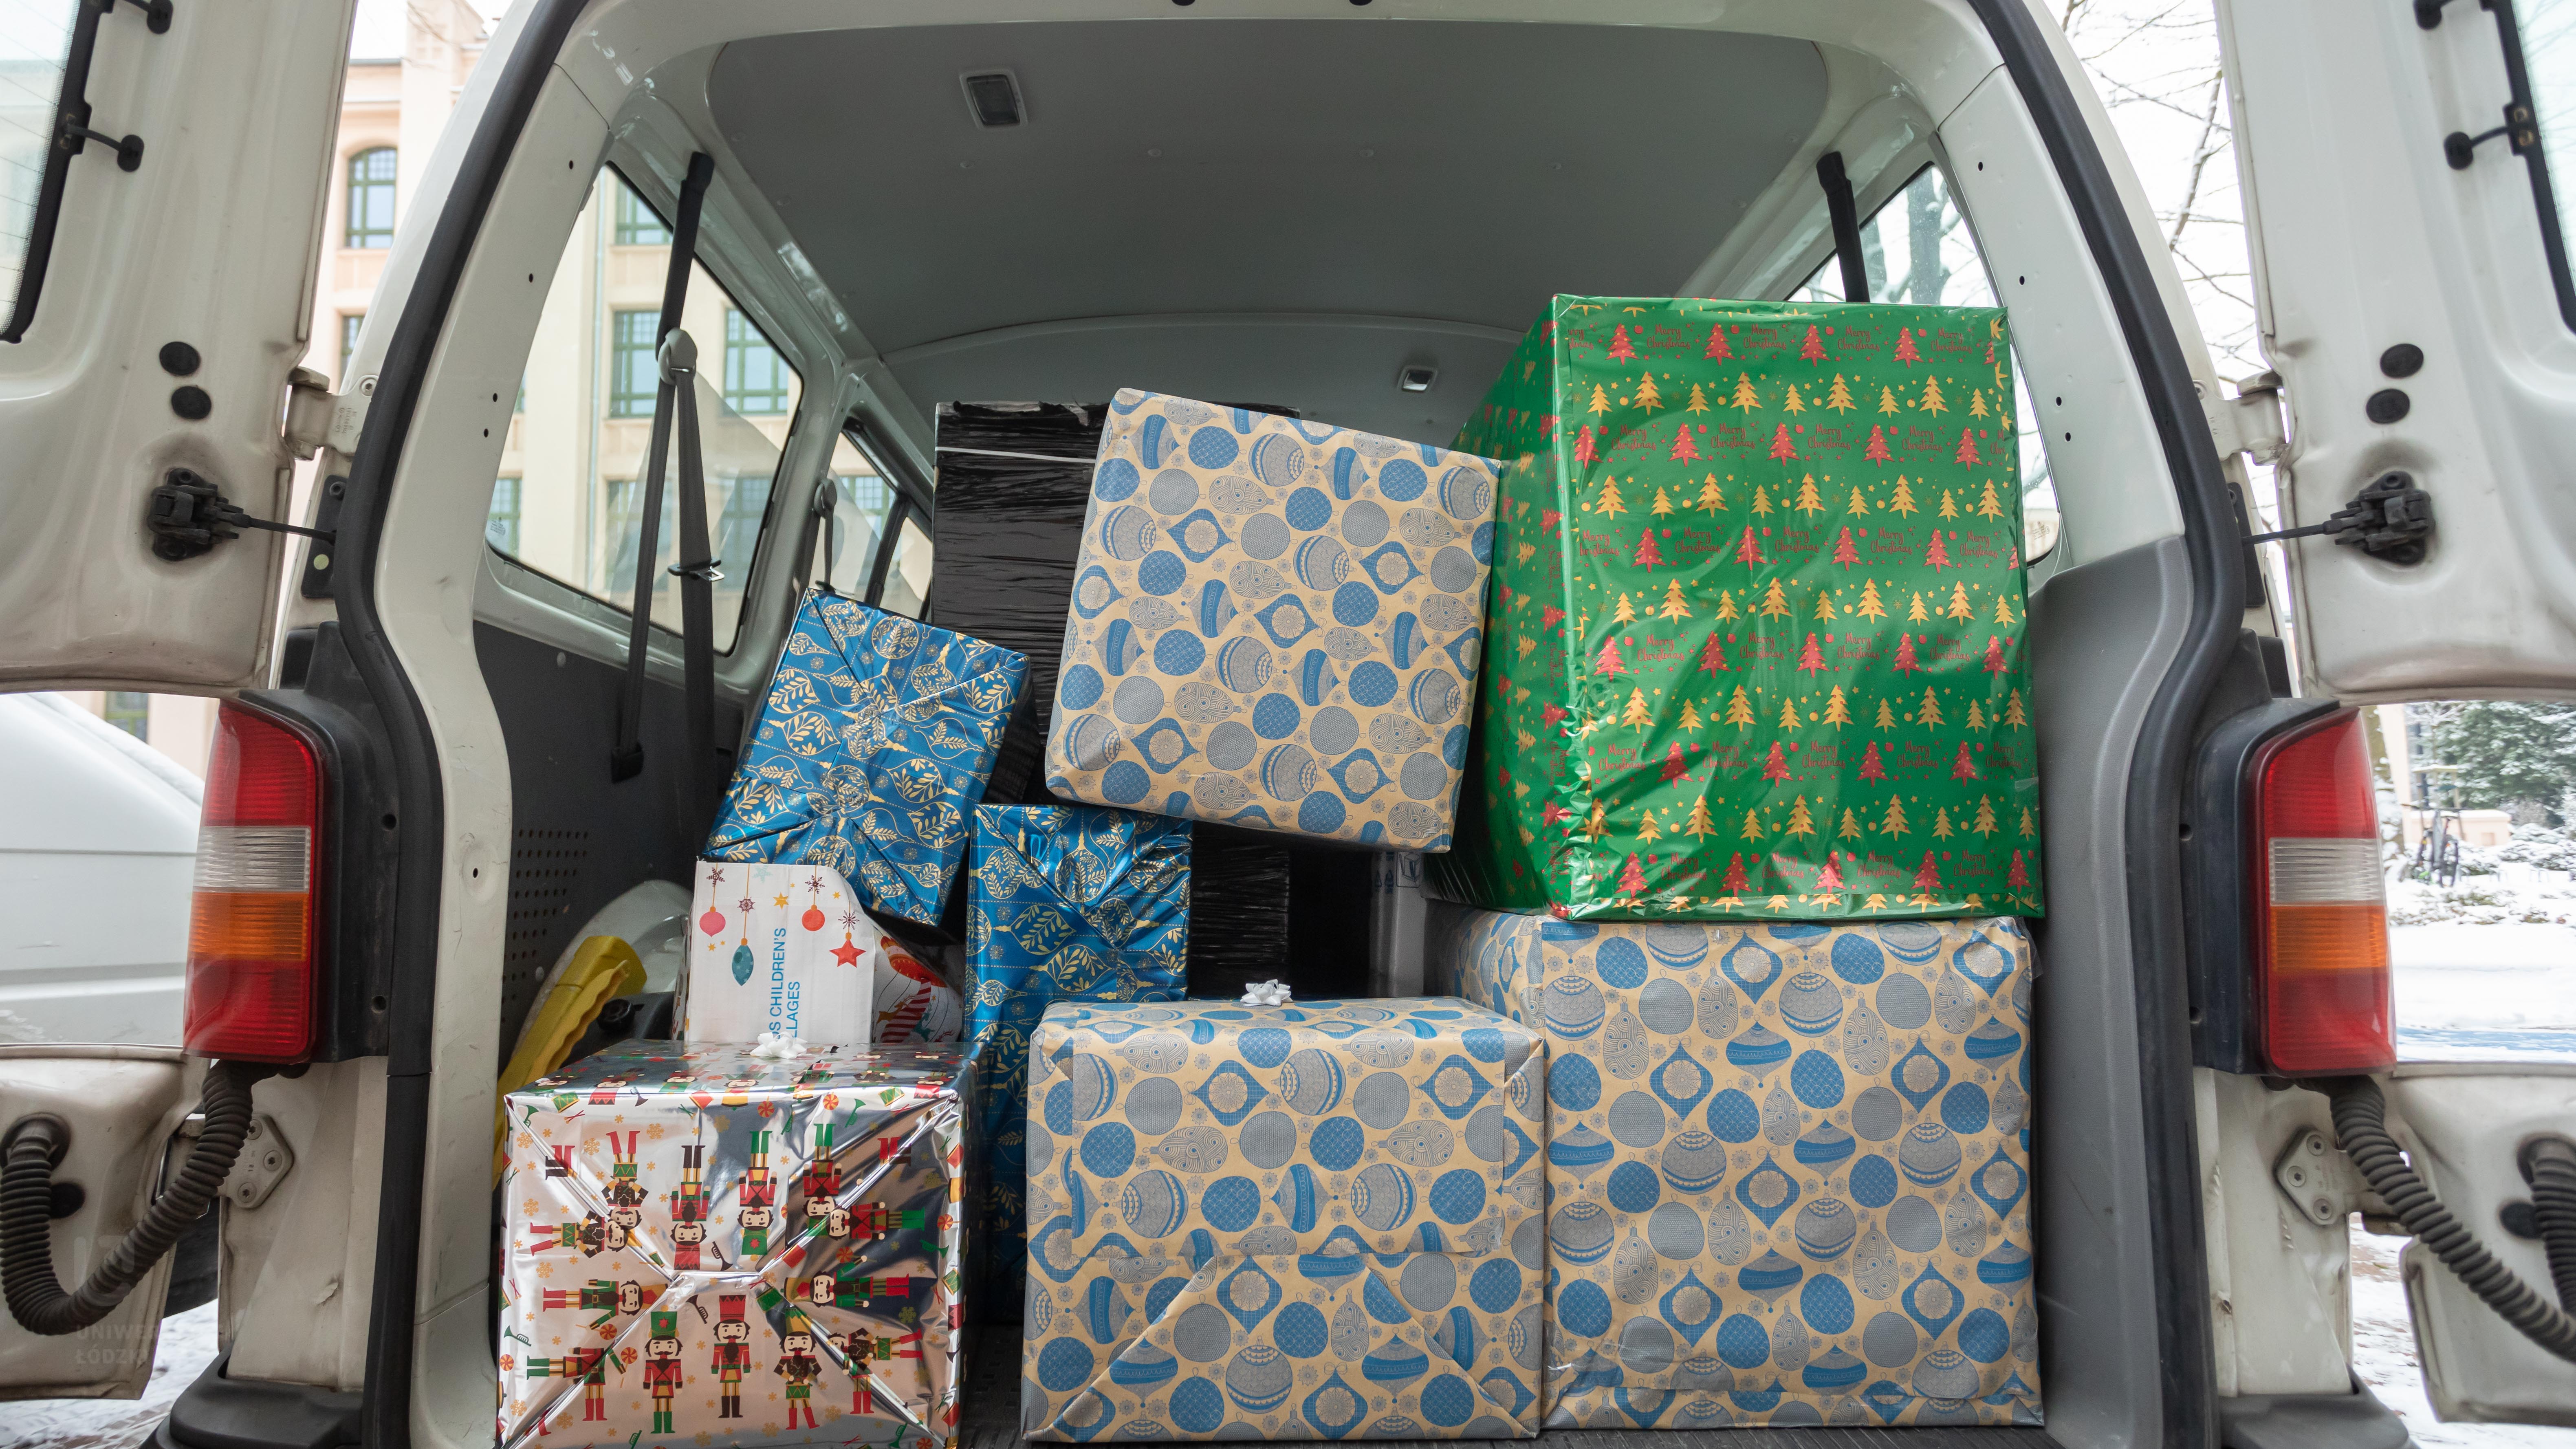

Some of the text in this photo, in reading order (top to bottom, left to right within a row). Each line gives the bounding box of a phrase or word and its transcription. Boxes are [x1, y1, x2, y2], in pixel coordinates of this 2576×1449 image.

[1655, 324, 1681, 342] Merry
[1752, 324, 1777, 342] Merry
[1845, 326, 1870, 344] Merry
[1938, 328, 1963, 344] Merry
[1647, 336, 1691, 350] Christmas
[1744, 337, 1786, 350] Christmas
[1838, 338, 1880, 352] Christmas
[1931, 340, 1972, 354] Christmas
[1620, 424, 1647, 443] Merry
[1719, 423, 1746, 442] Merry
[1816, 423, 1841, 442] Merry
[1910, 425, 1934, 445] Merry
[1612, 436, 1656, 451] Christmas
[1711, 435, 1755, 449] Christmas
[1808, 436, 1851, 450] Christmas
[1902, 437, 1943, 452] Christmas
[1583, 530, 1610, 548] Merry
[1684, 527, 1711, 544] Merry
[1783, 526, 1809, 544] Merry
[1878, 527, 1904, 544] Merry
[1967, 531, 1990, 547] Merry
[1675, 540, 1721, 554] Christmas
[1775, 538, 1819, 553] Christmas
[1871, 540, 1913, 555] Christmas
[1960, 544, 1998, 559] Christmas
[1647, 634, 1674, 652] Merry
[1749, 632, 1775, 650] Merry
[1845, 632, 1871, 651] Merry
[1937, 634, 1961, 652] Merry
[1638, 647, 1684, 662] Christmas
[1740, 645, 1784, 661] Christmas
[1837, 645, 1880, 660] Christmas
[1930, 647, 1971, 662] Christmas
[1608, 744, 1637, 762] Merry
[1713, 741, 1739, 761] Merry
[1811, 741, 1837, 759] Merry
[1905, 740, 1930, 759] Merry
[1993, 742, 2014, 759] Merry
[1599, 756, 1647, 771] Christmas
[1703, 755, 1748, 770] Christmas
[1802, 753, 1845, 769] Christmas
[1897, 754, 1938, 769] Christmas
[1986, 754, 2021, 769] Christmas
[1671, 853, 1698, 870] Merry
[1772, 852, 1798, 869] Merry
[1867, 851, 1893, 868] Merry
[1962, 850, 1986, 868] Merry
[1661, 865, 1707, 881] Christmas
[1762, 865, 1804, 879] Christmas
[1857, 863, 1901, 878] Christmas
[1954, 863, 1994, 878] Christmas
